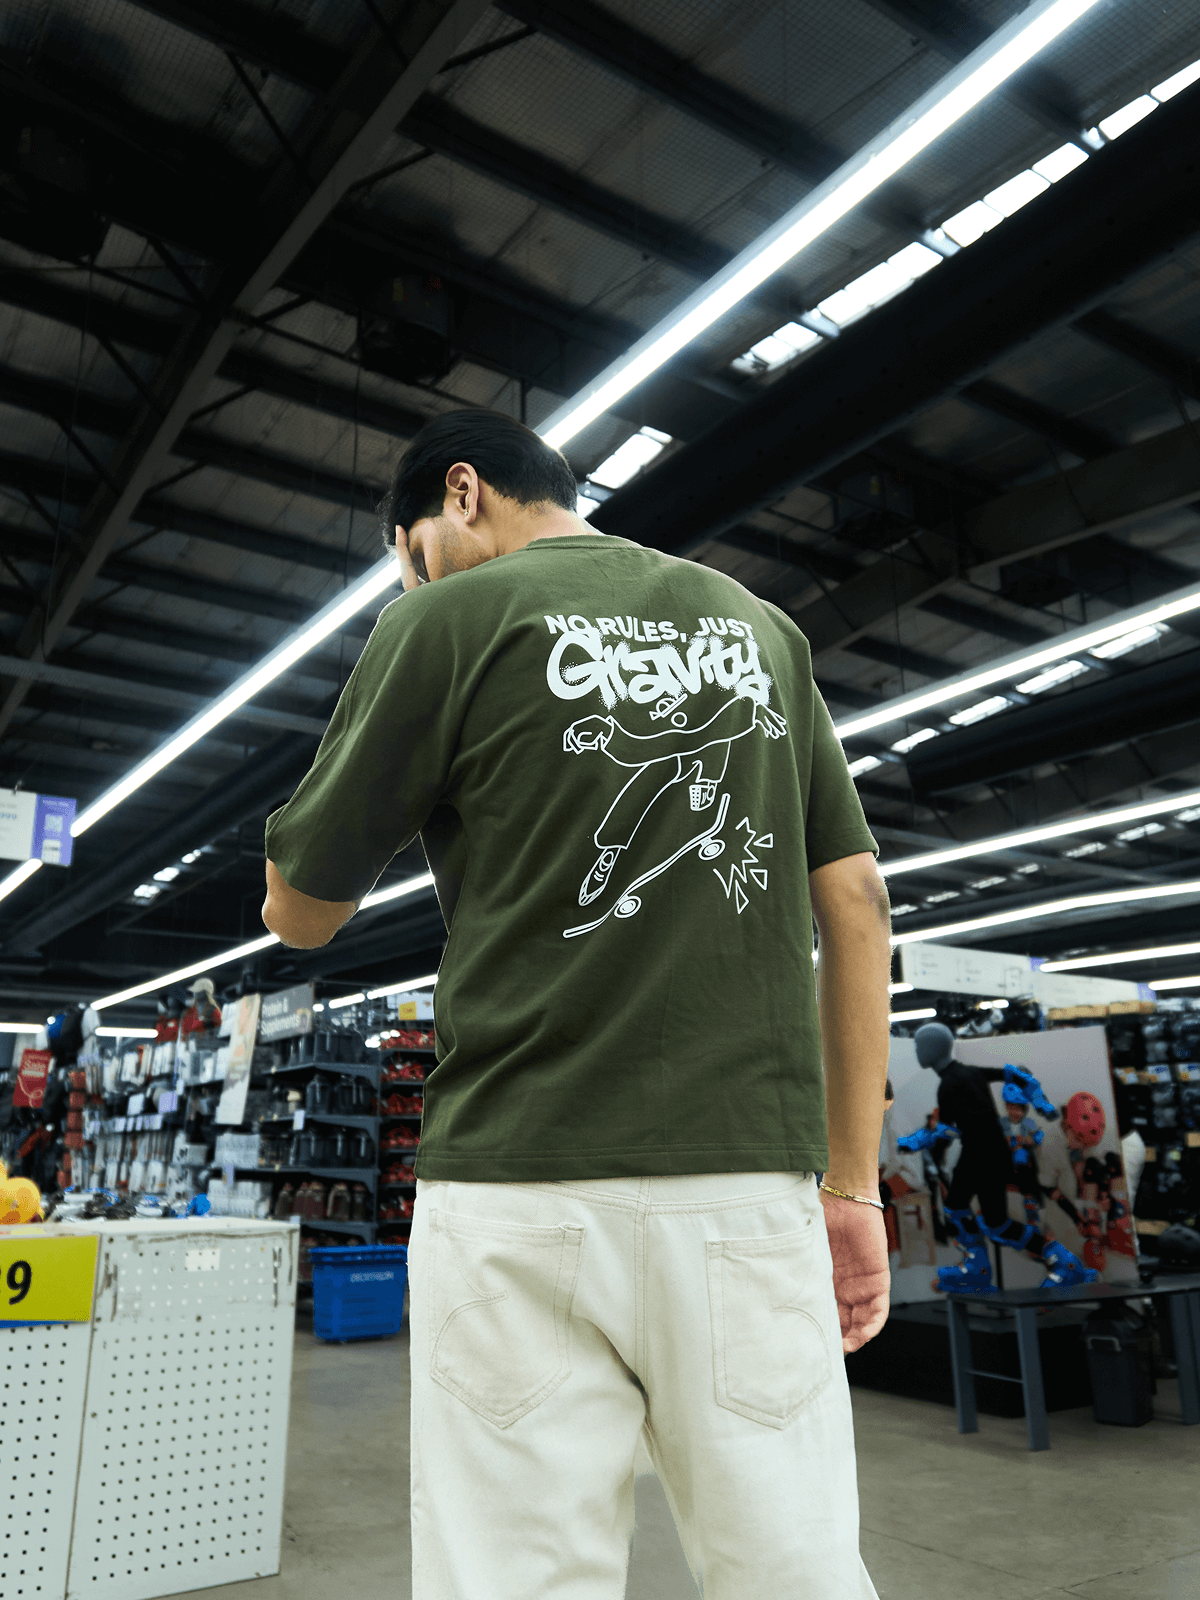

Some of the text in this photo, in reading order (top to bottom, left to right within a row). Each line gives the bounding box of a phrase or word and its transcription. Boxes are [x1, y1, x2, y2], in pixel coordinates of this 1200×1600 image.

[544, 615, 755, 643] NO RULES, JUST
[547, 630, 772, 709] Gravity
